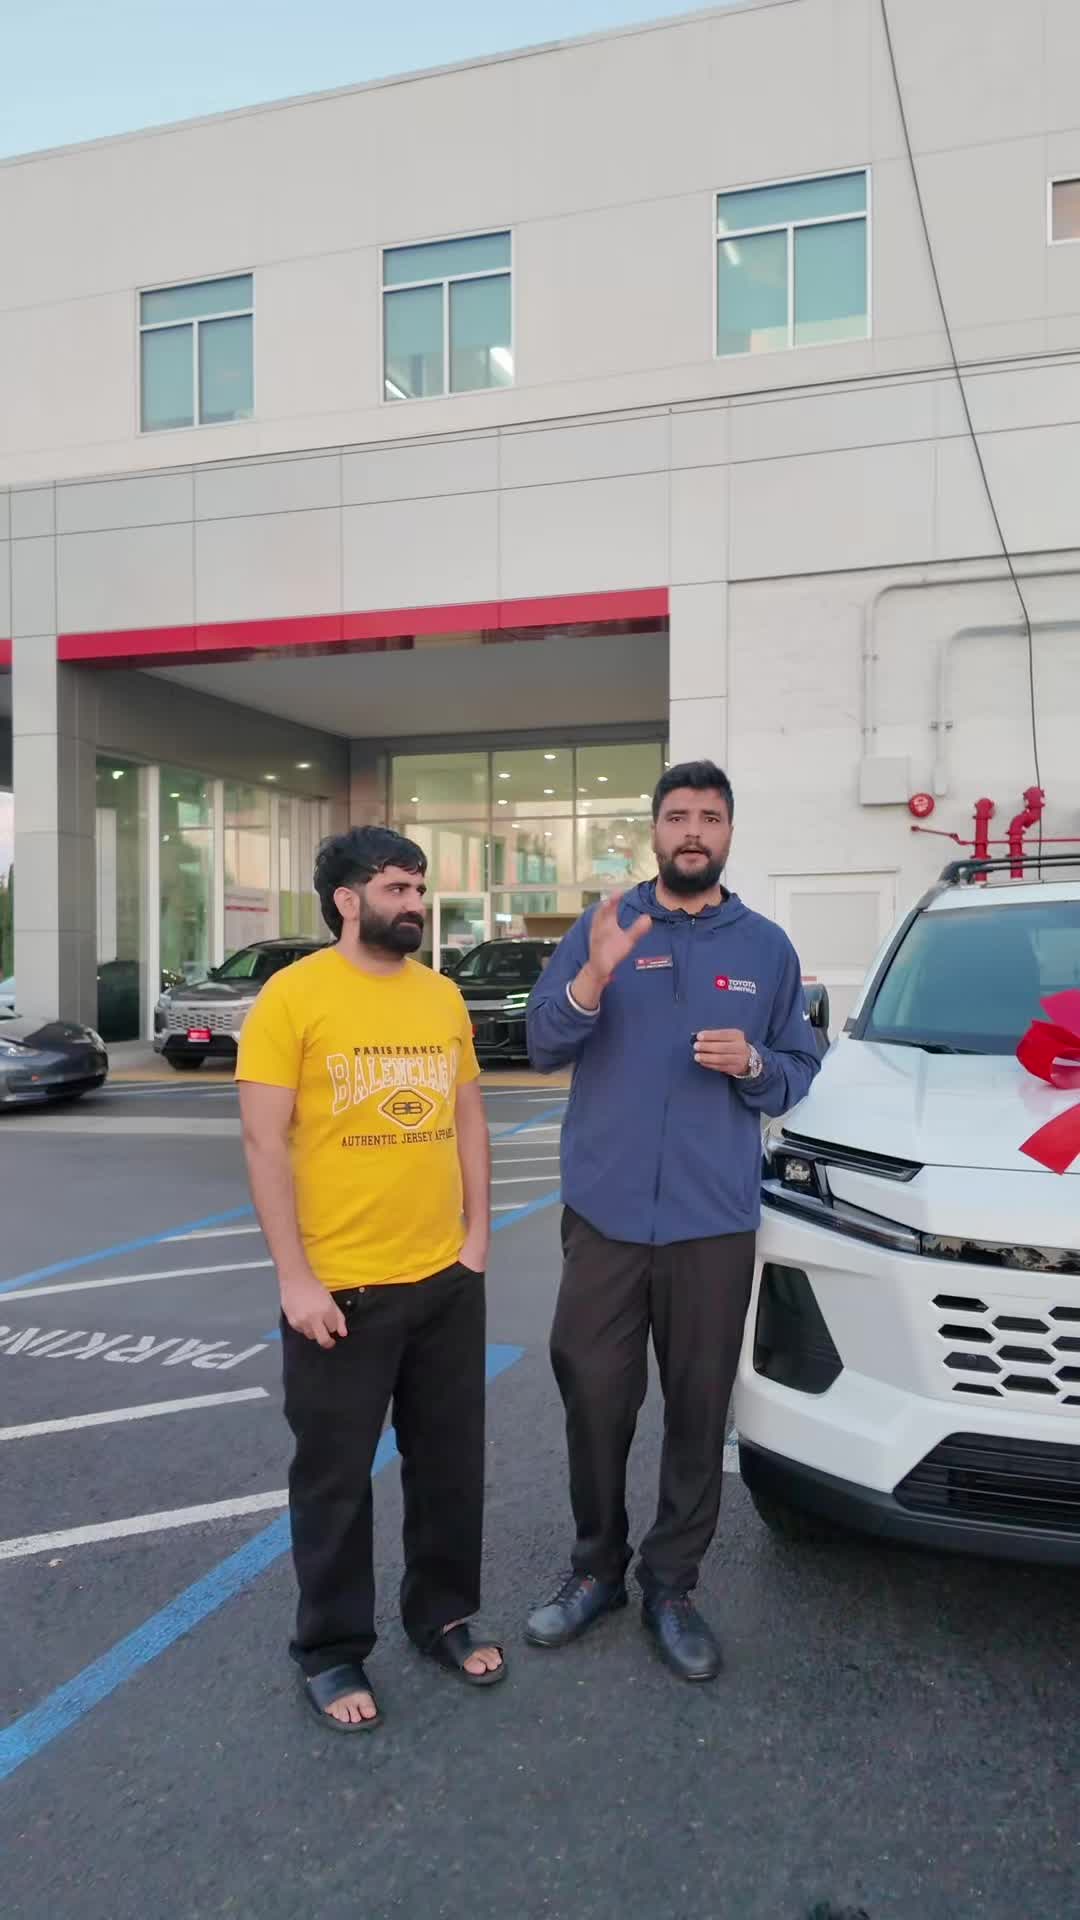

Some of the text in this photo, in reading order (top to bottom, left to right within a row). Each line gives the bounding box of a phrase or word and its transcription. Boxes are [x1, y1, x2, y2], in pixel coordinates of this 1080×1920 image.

[728, 979, 756, 988] TOYOTA
[353, 1045, 443, 1055] PARIS FRANCE
[342, 1134, 397, 1147] AUTHENTIC
[401, 1131, 433, 1144] JERSEY
[0, 1326, 269, 1370] PARKIN
